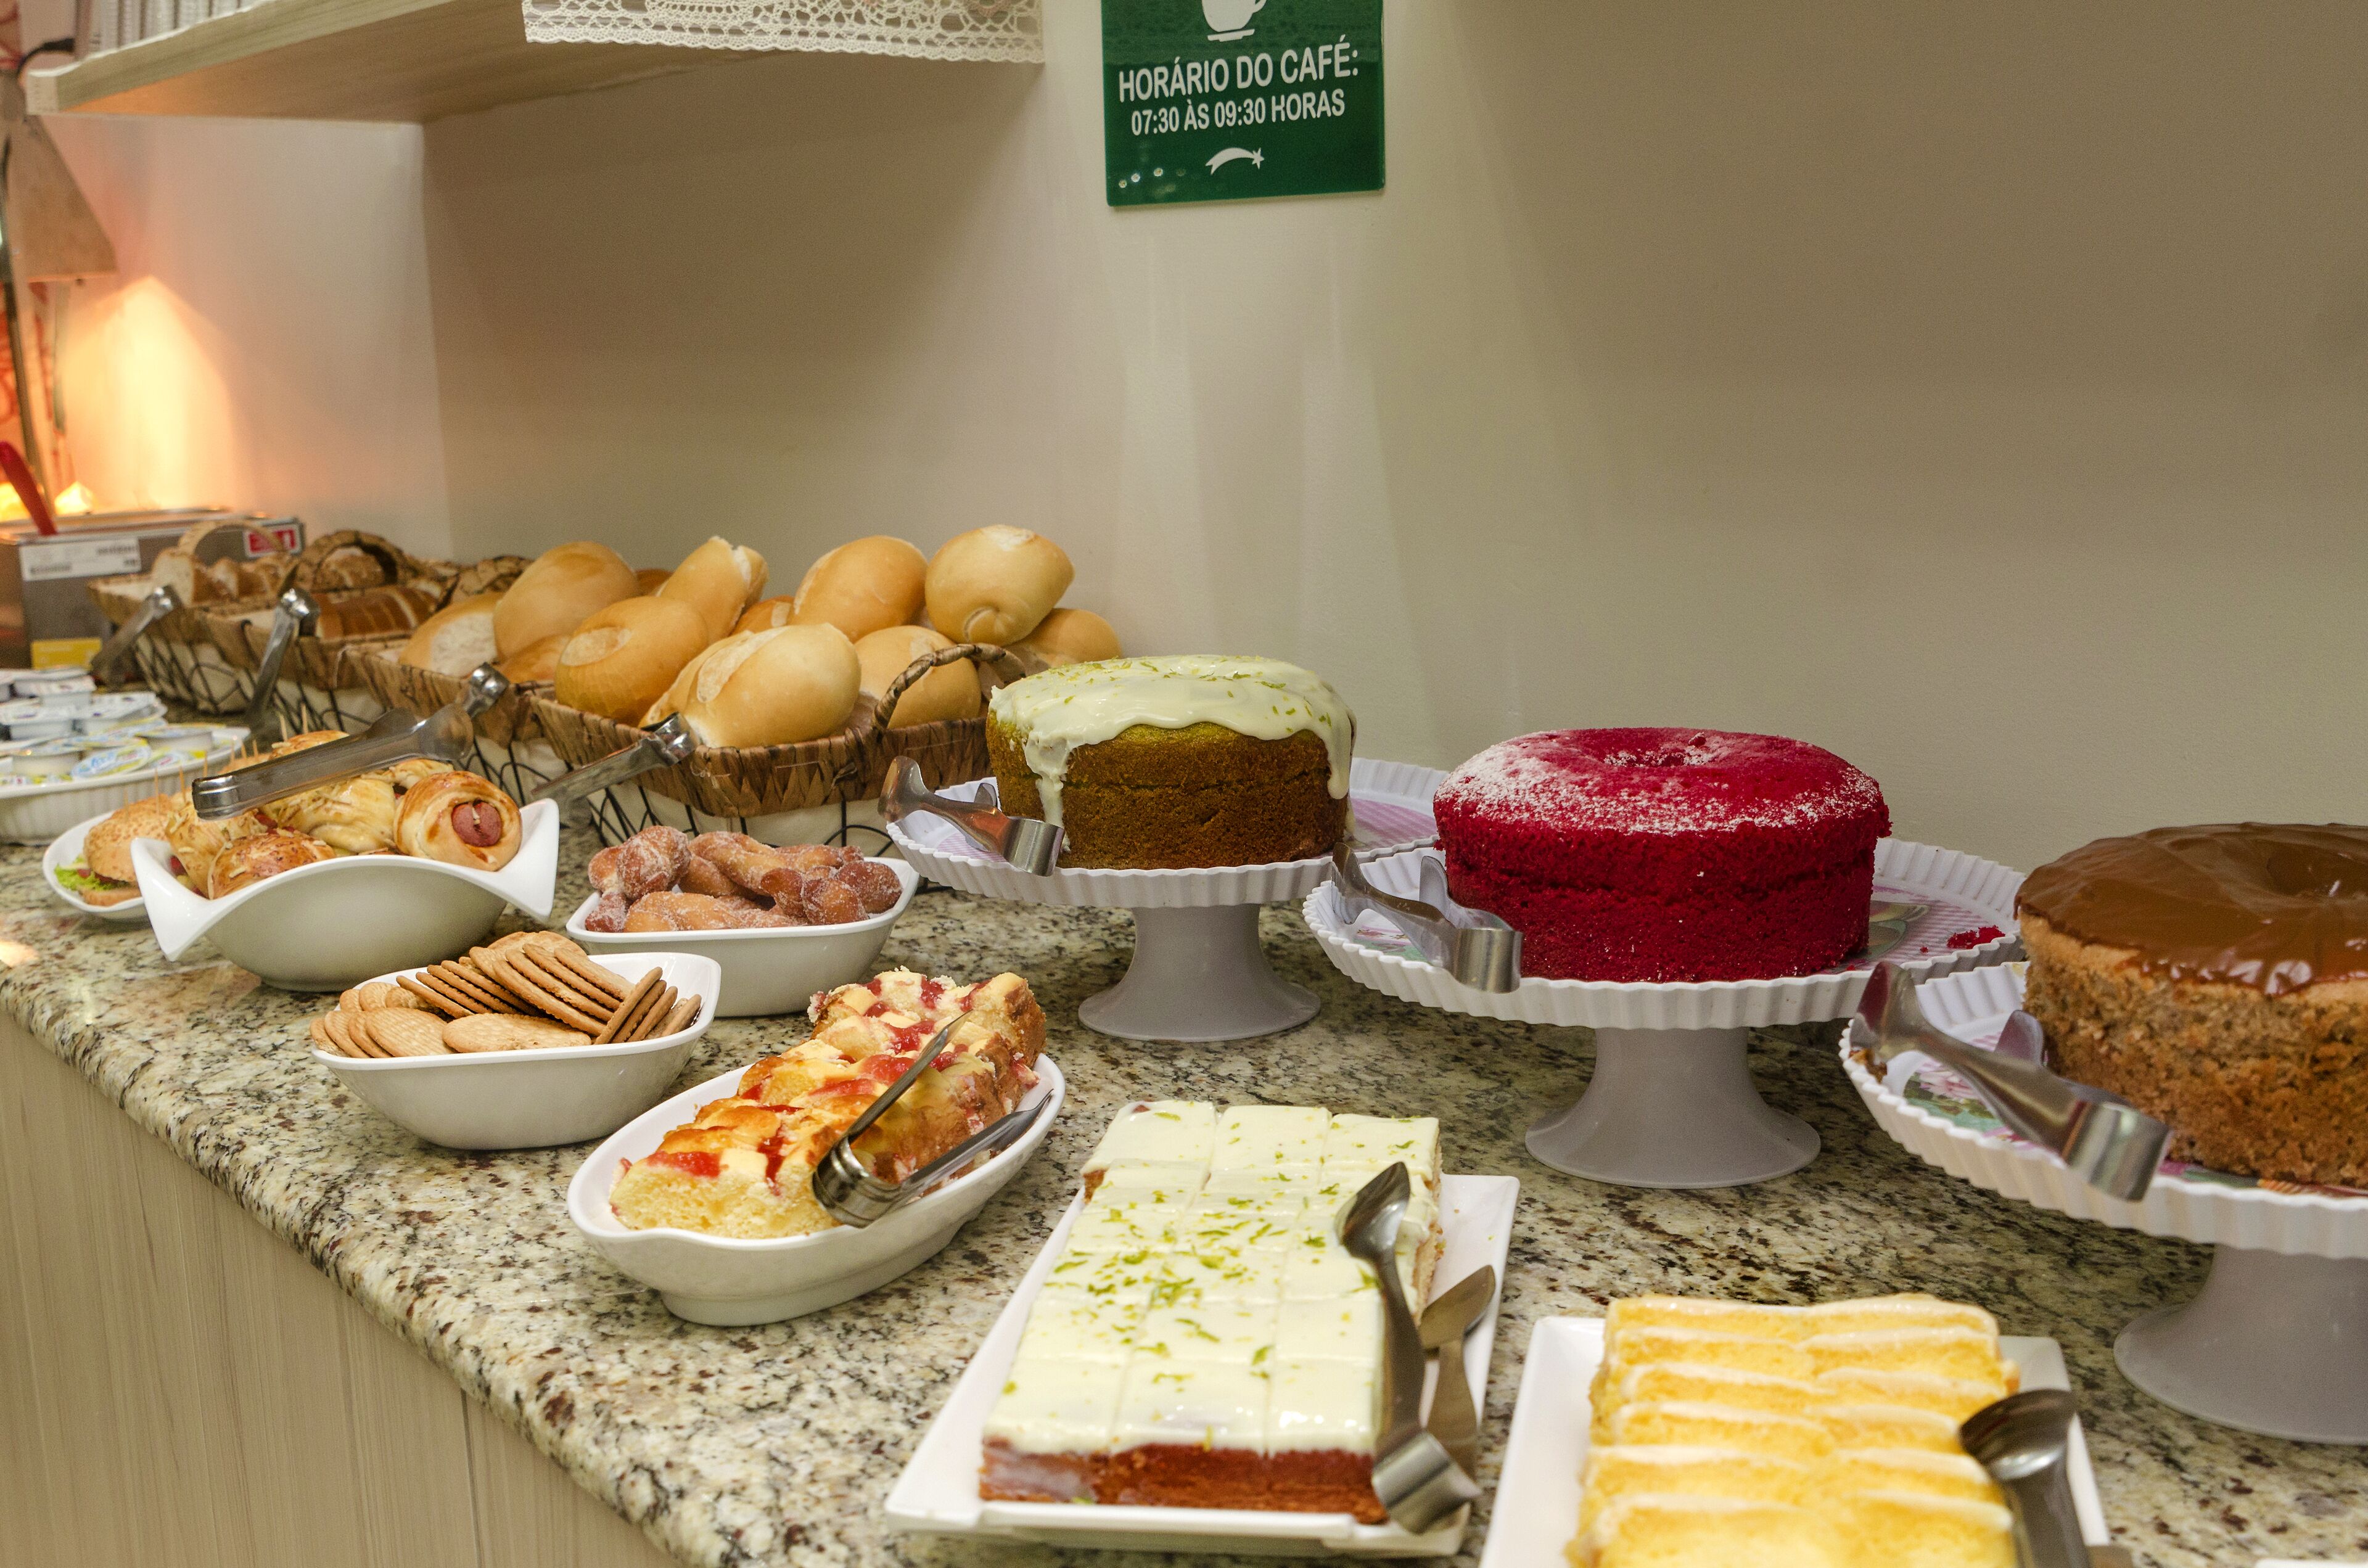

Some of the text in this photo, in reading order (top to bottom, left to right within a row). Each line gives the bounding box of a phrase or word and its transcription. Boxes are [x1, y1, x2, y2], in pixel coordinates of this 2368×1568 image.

[1119, 34, 1359, 102] HORÁRIO DO CAFÉ:
[1131, 88, 1345, 136] 07:30 ÀS 09:30 HORAS
